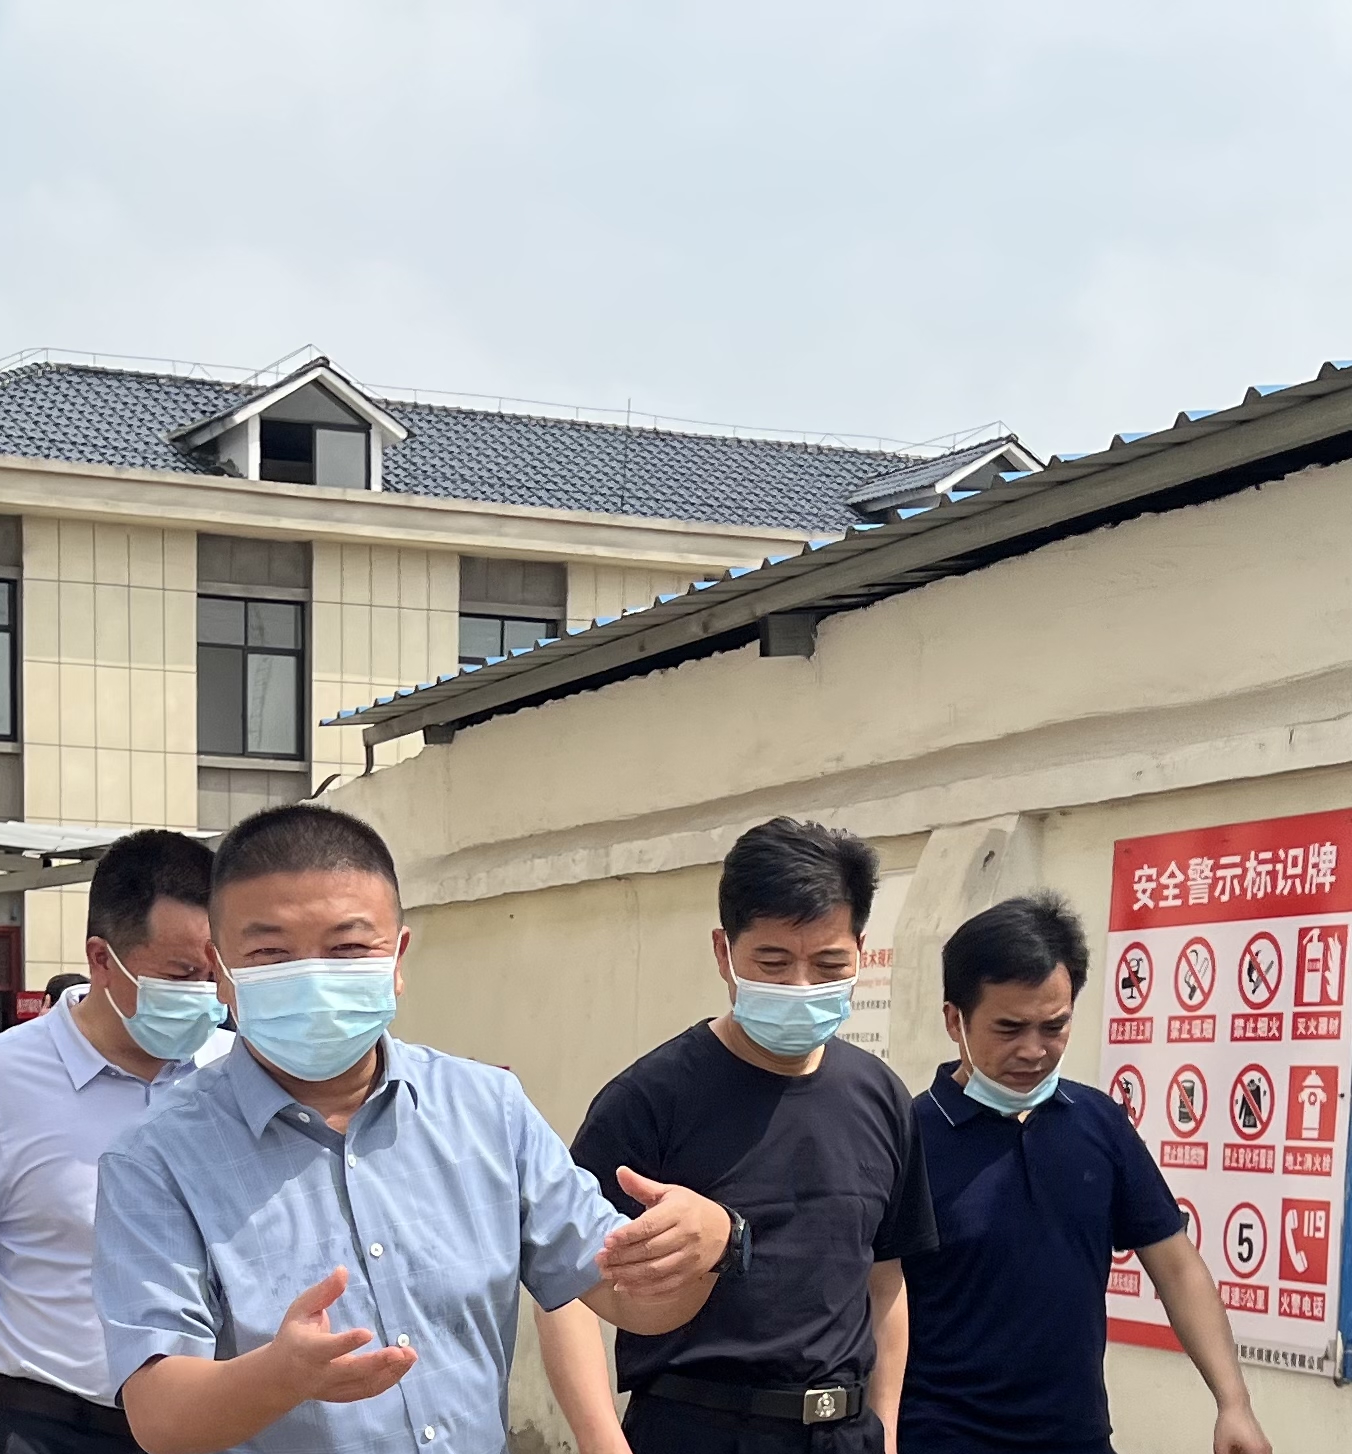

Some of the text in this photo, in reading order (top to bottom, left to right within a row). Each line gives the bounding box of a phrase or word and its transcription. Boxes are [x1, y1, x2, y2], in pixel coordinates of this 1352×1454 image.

[1133, 842, 1338, 911] 安全警示标识牌
[1233, 1017, 1280, 1038] 禁止烟火
[1303, 1210, 1325, 1238] 119
[1237, 1223, 1254, 1263] 5
[1280, 1292, 1324, 1318] 火警电话
